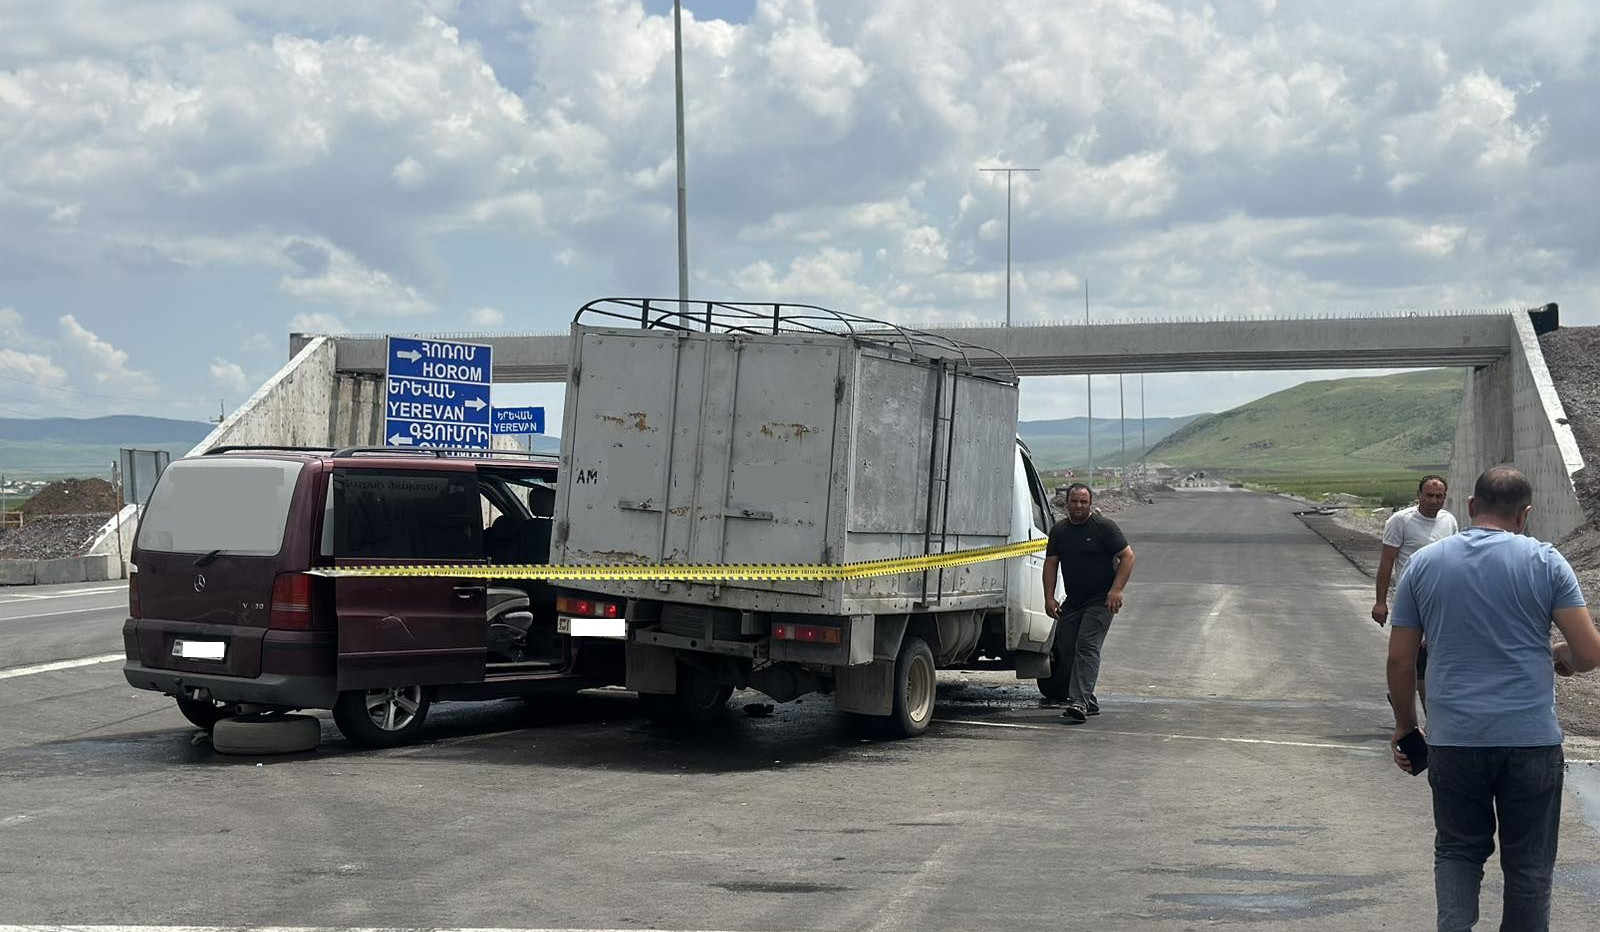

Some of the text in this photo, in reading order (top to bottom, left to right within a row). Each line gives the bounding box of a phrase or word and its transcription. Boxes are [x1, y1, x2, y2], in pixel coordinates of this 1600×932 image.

[422, 342, 476, 361] ՀՈՌՈՄ
[422, 362, 482, 381] HOROM
[389, 379, 456, 399] ԵՐԵՎԱՆ
[389, 401, 465, 421] YEREVAN
[497, 411, 533, 421] ԵՐԵՎԱՆ
[409, 423, 488, 443] ԳՅՈՒՄՐԻ
[493, 422, 537, 432] YEREVAN
[576, 469, 598, 484] AM
